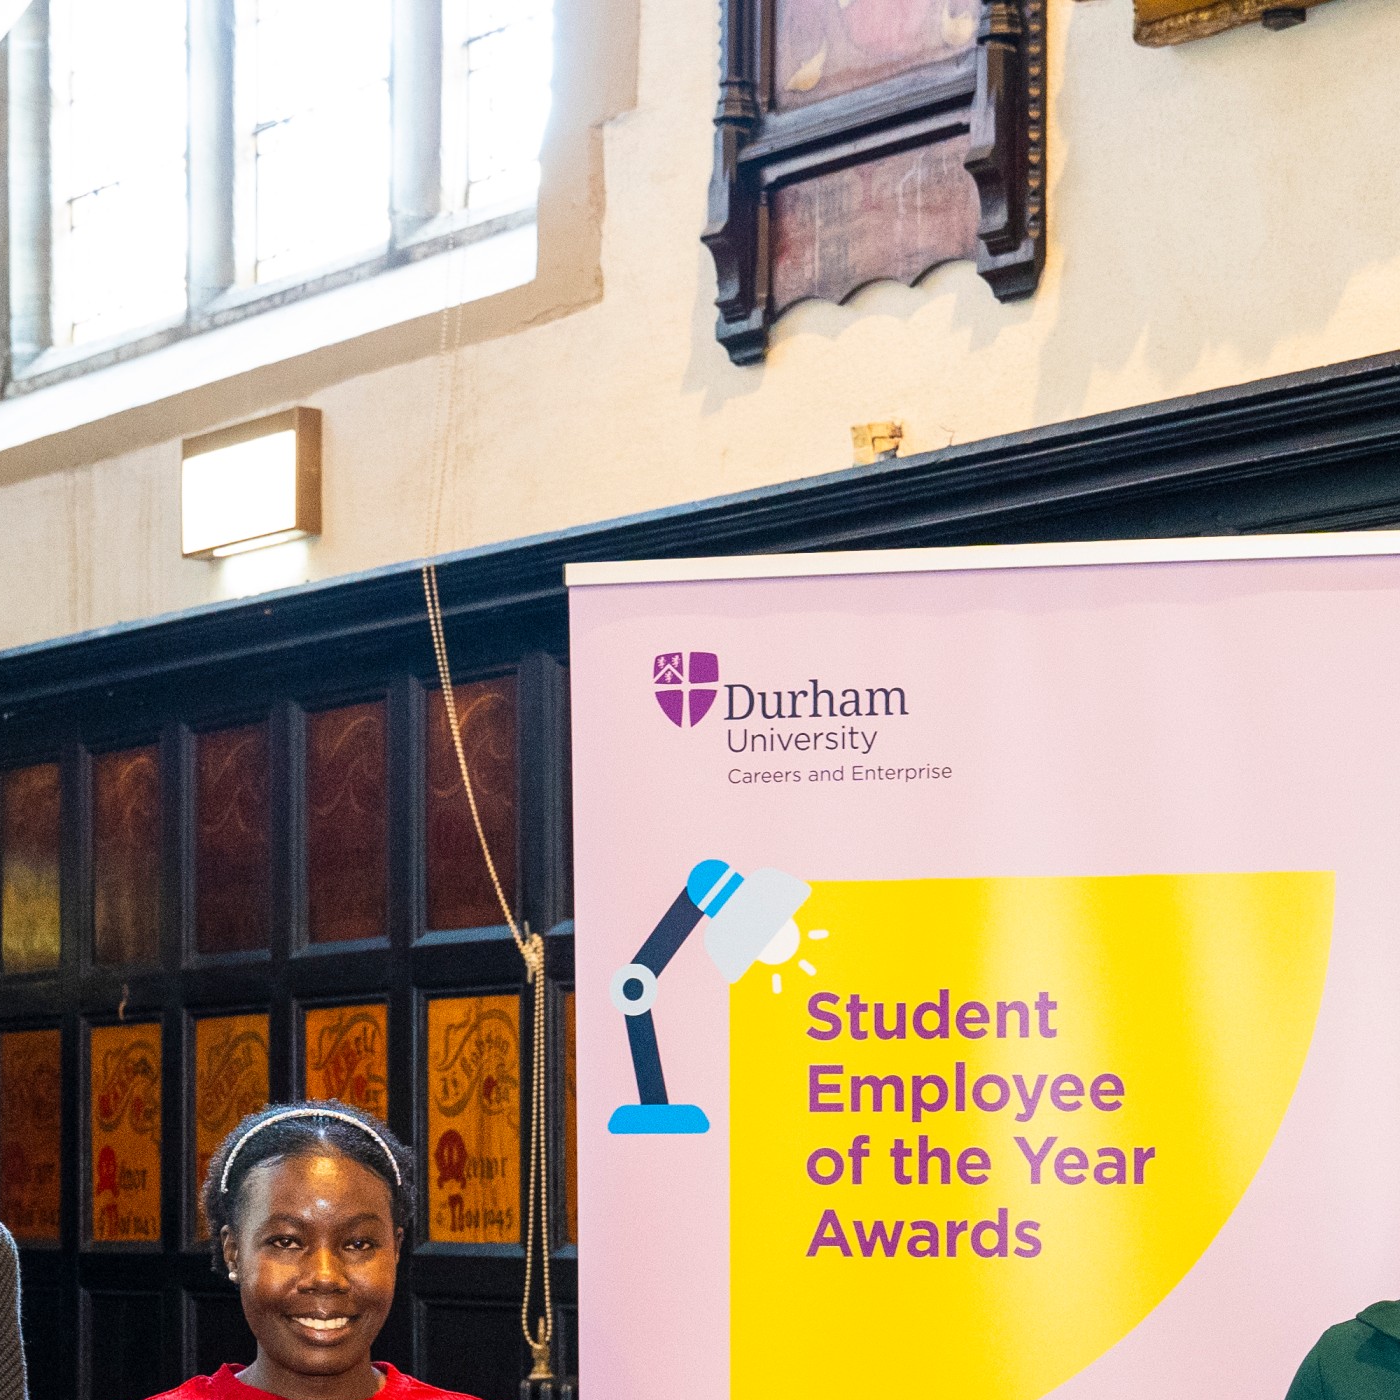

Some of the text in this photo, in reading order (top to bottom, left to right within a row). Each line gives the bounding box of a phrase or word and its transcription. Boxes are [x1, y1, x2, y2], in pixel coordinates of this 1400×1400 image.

[724, 679, 909, 720] Durham
[728, 726, 878, 754] University
[728, 764, 952, 784] Careers and Enterprise
[806, 989, 1058, 1041] Student
[809, 1062, 1125, 1123] Employee
[806, 1135, 1155, 1186] of the Year
[805, 1207, 1042, 1258] Awards
